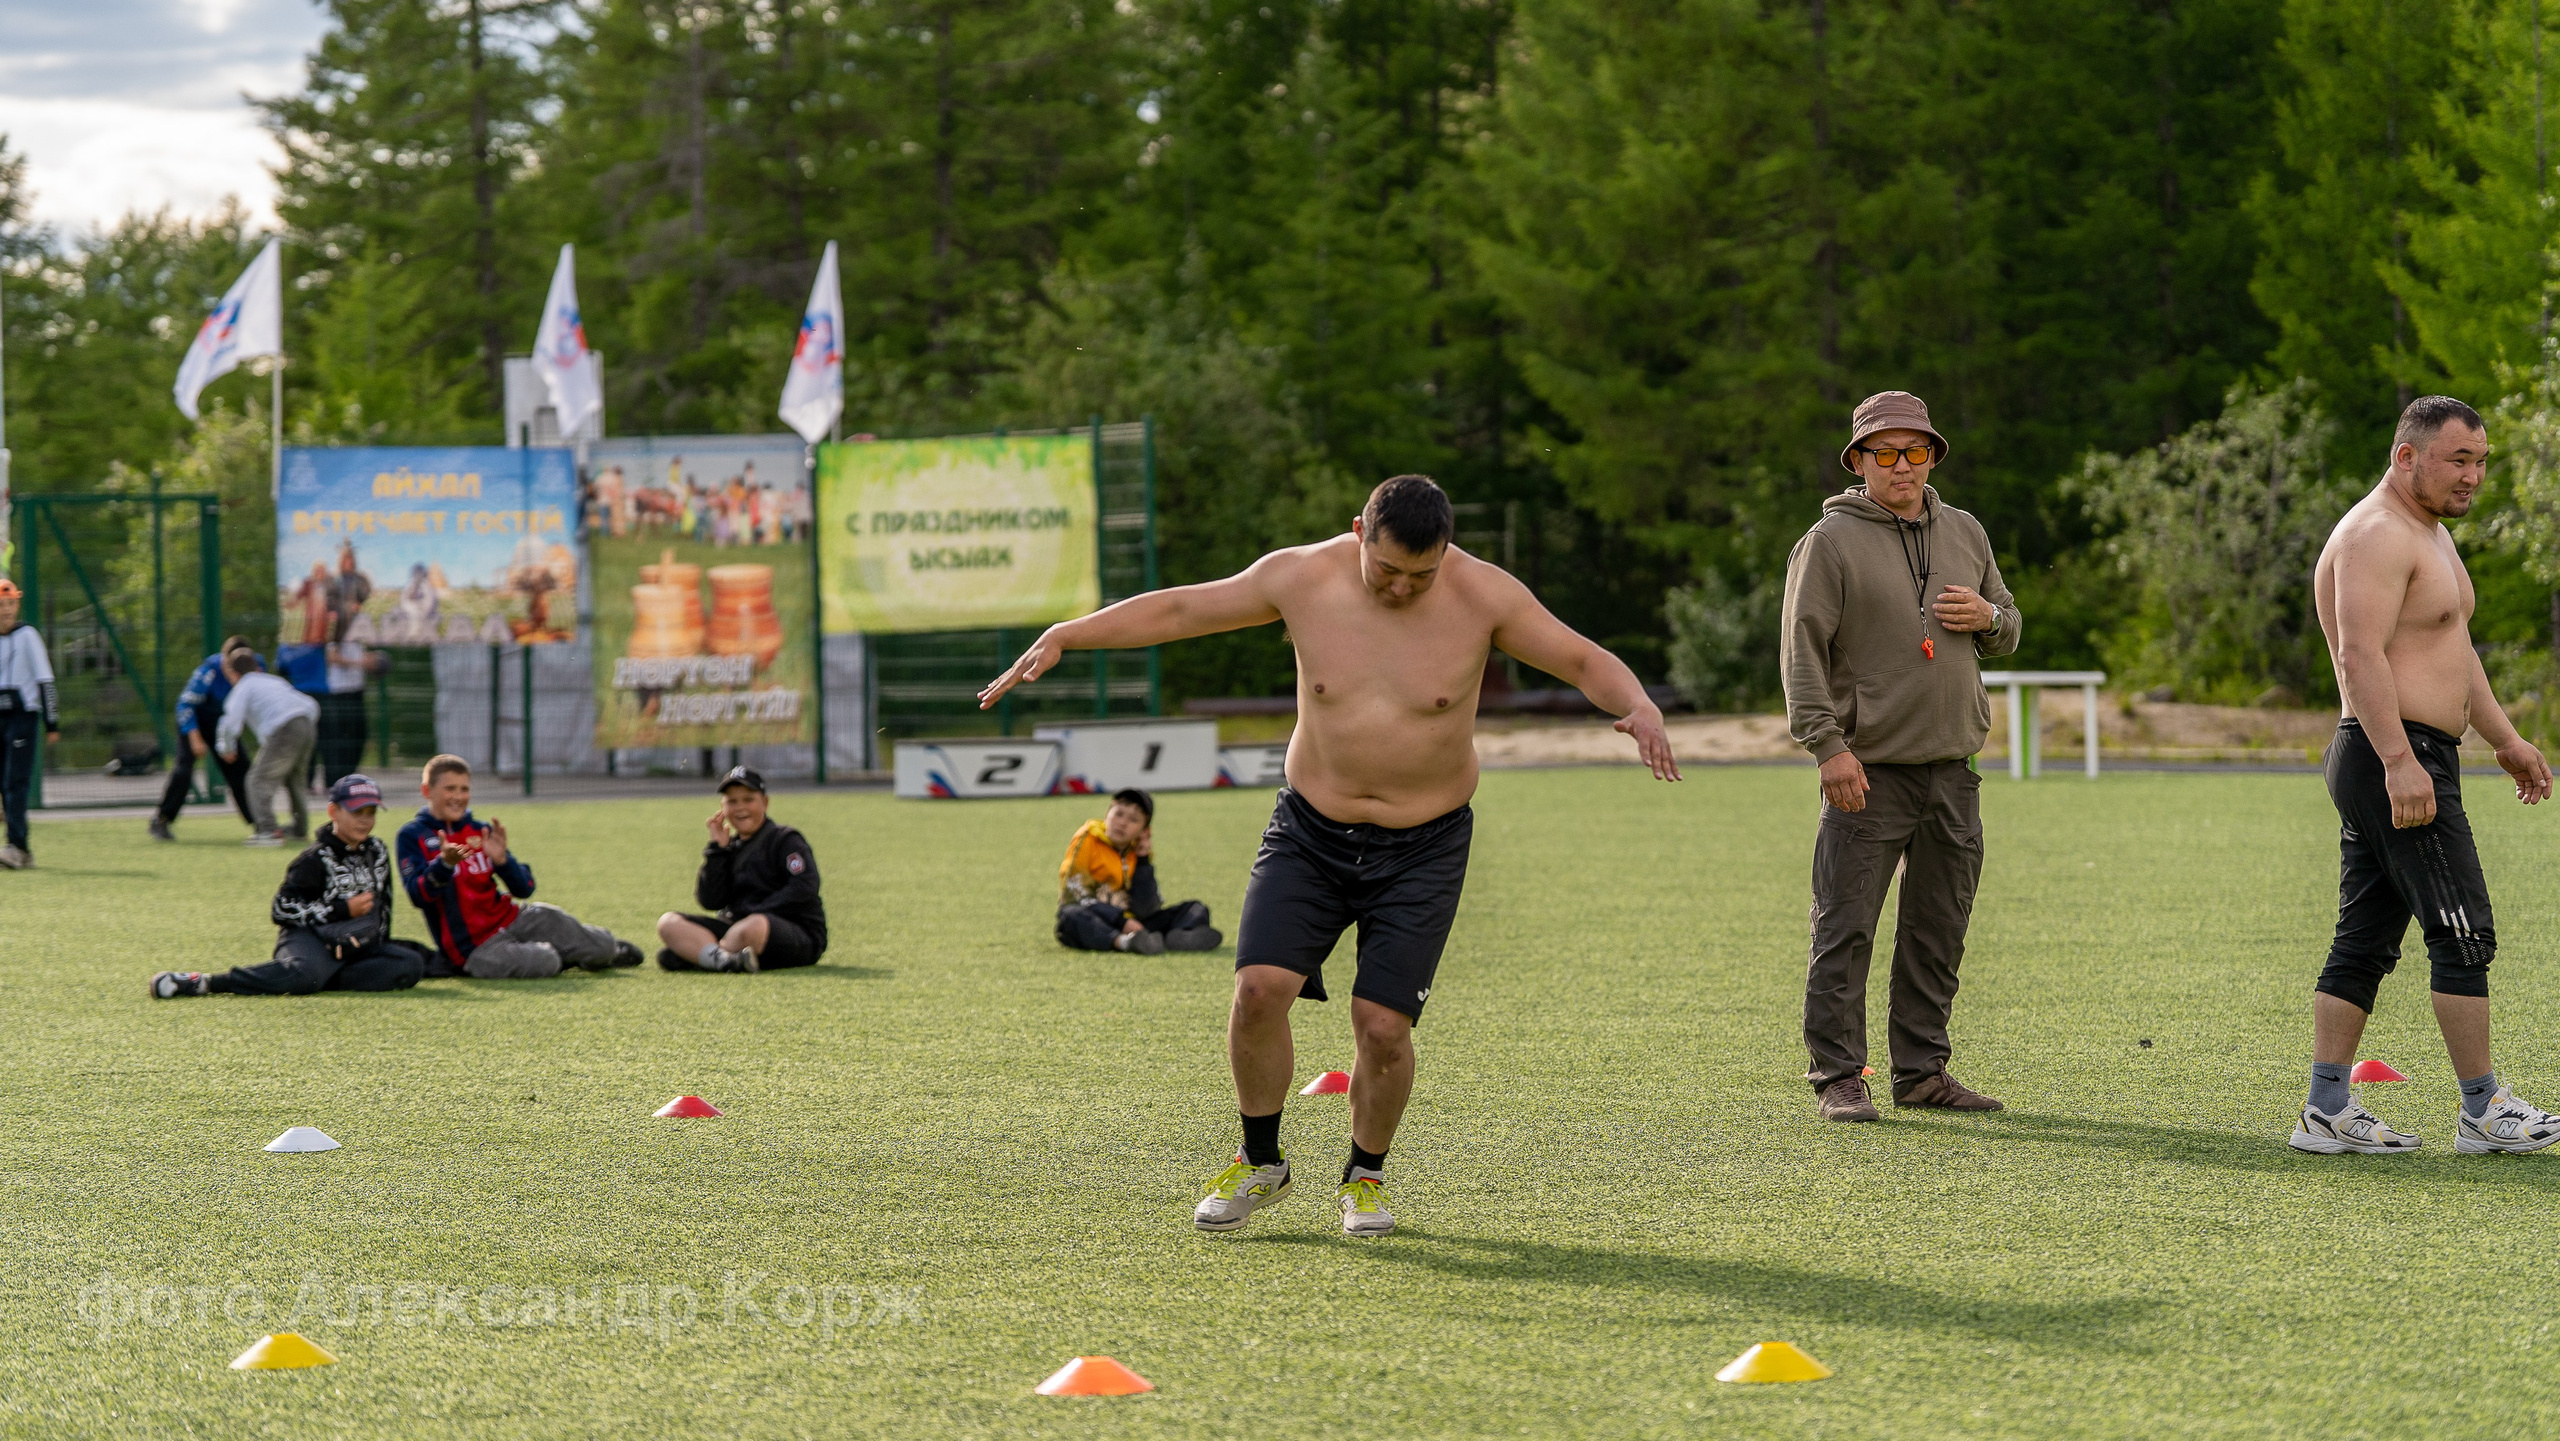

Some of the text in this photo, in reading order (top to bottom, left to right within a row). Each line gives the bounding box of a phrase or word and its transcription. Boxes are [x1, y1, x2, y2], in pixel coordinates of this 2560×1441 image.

[372, 466, 482, 498] АЙХАЛ
[293, 505, 564, 534] ВСТРЕЧАЕТ ГОСТЕЙ
[846, 507, 1071, 534] С ПРАЗДНИКОМ
[910, 546, 1013, 570] ЫСЫАХ
[976, 755, 1024, 785] 2
[1141, 742, 1164, 772] 1
